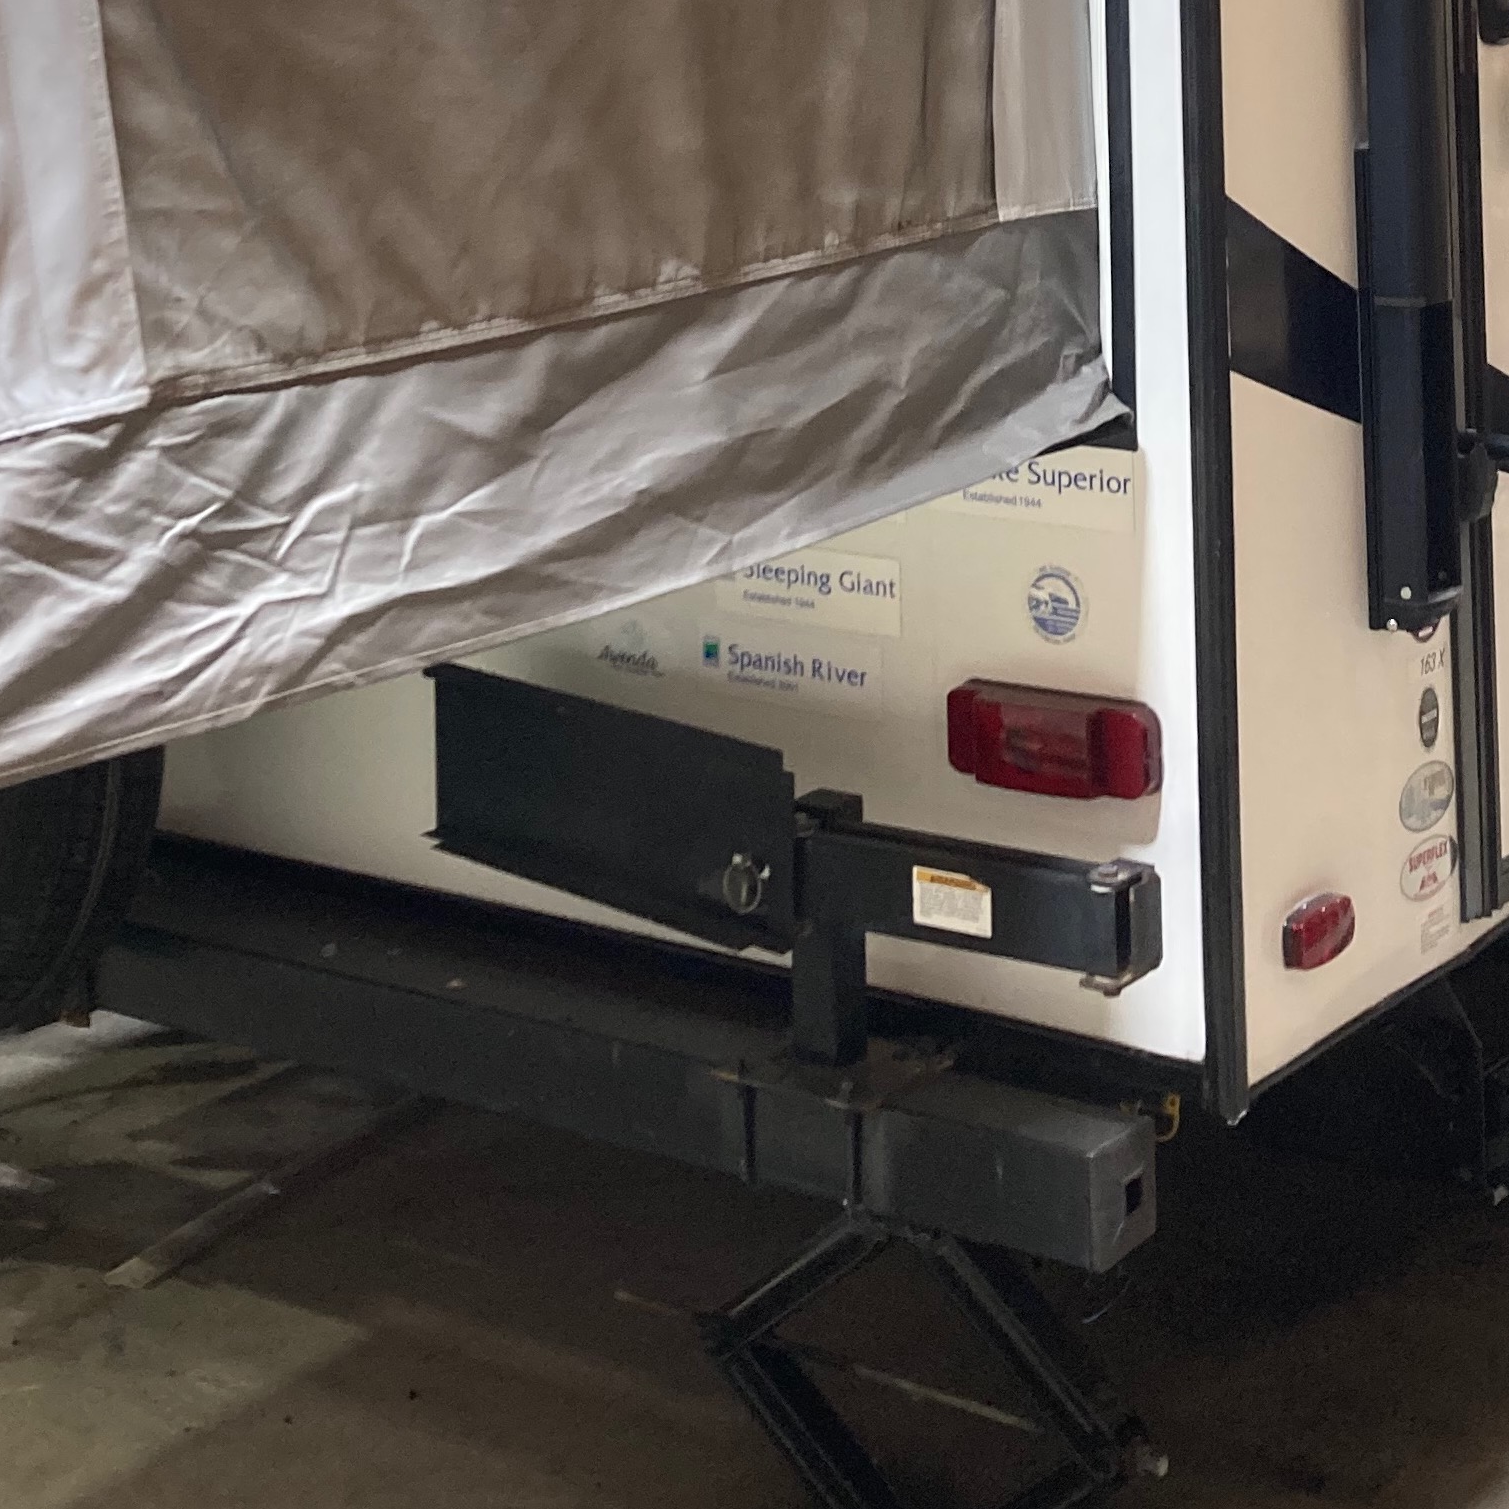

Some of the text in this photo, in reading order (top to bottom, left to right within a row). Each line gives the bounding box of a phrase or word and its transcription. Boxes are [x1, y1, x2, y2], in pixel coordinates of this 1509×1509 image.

[1027, 460, 1132, 495] Superior
[744, 563, 897, 599] Sleeping Giant
[728, 643, 868, 688] Spanish River
